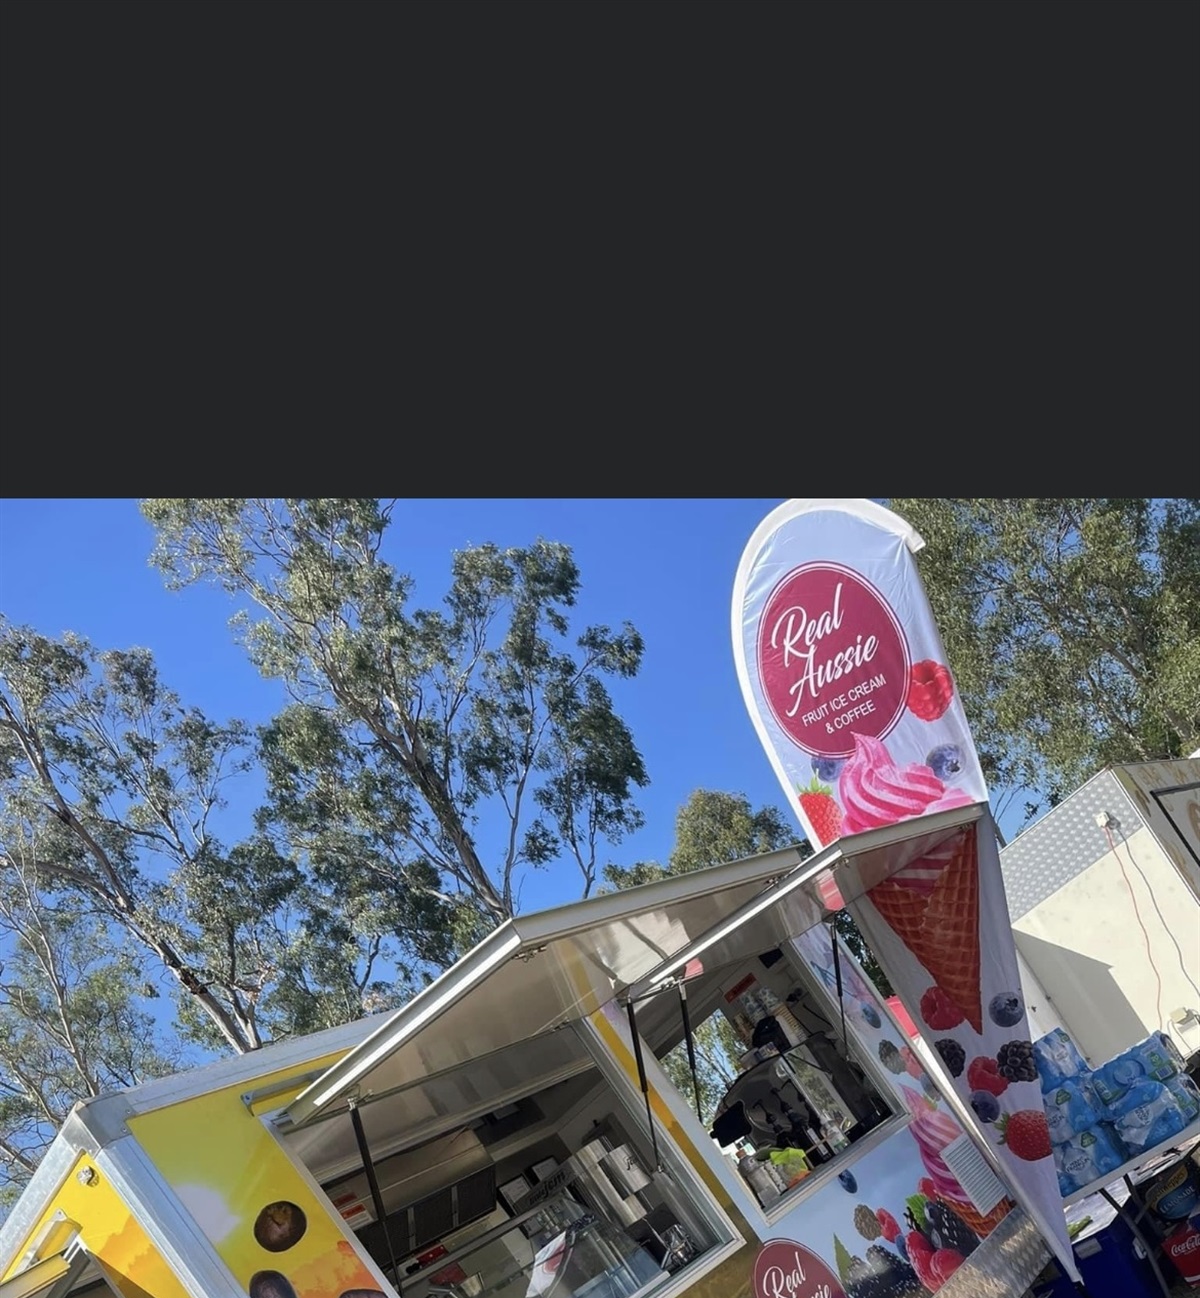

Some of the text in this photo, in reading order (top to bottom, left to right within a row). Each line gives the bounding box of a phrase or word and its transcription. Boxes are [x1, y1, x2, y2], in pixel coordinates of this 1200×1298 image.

[771, 583, 844, 668] Real
[785, 634, 879, 717] Aussie
[801, 673, 887, 727] FRUIT ICE CREAM
[825, 699, 876, 734] & COFFEE
